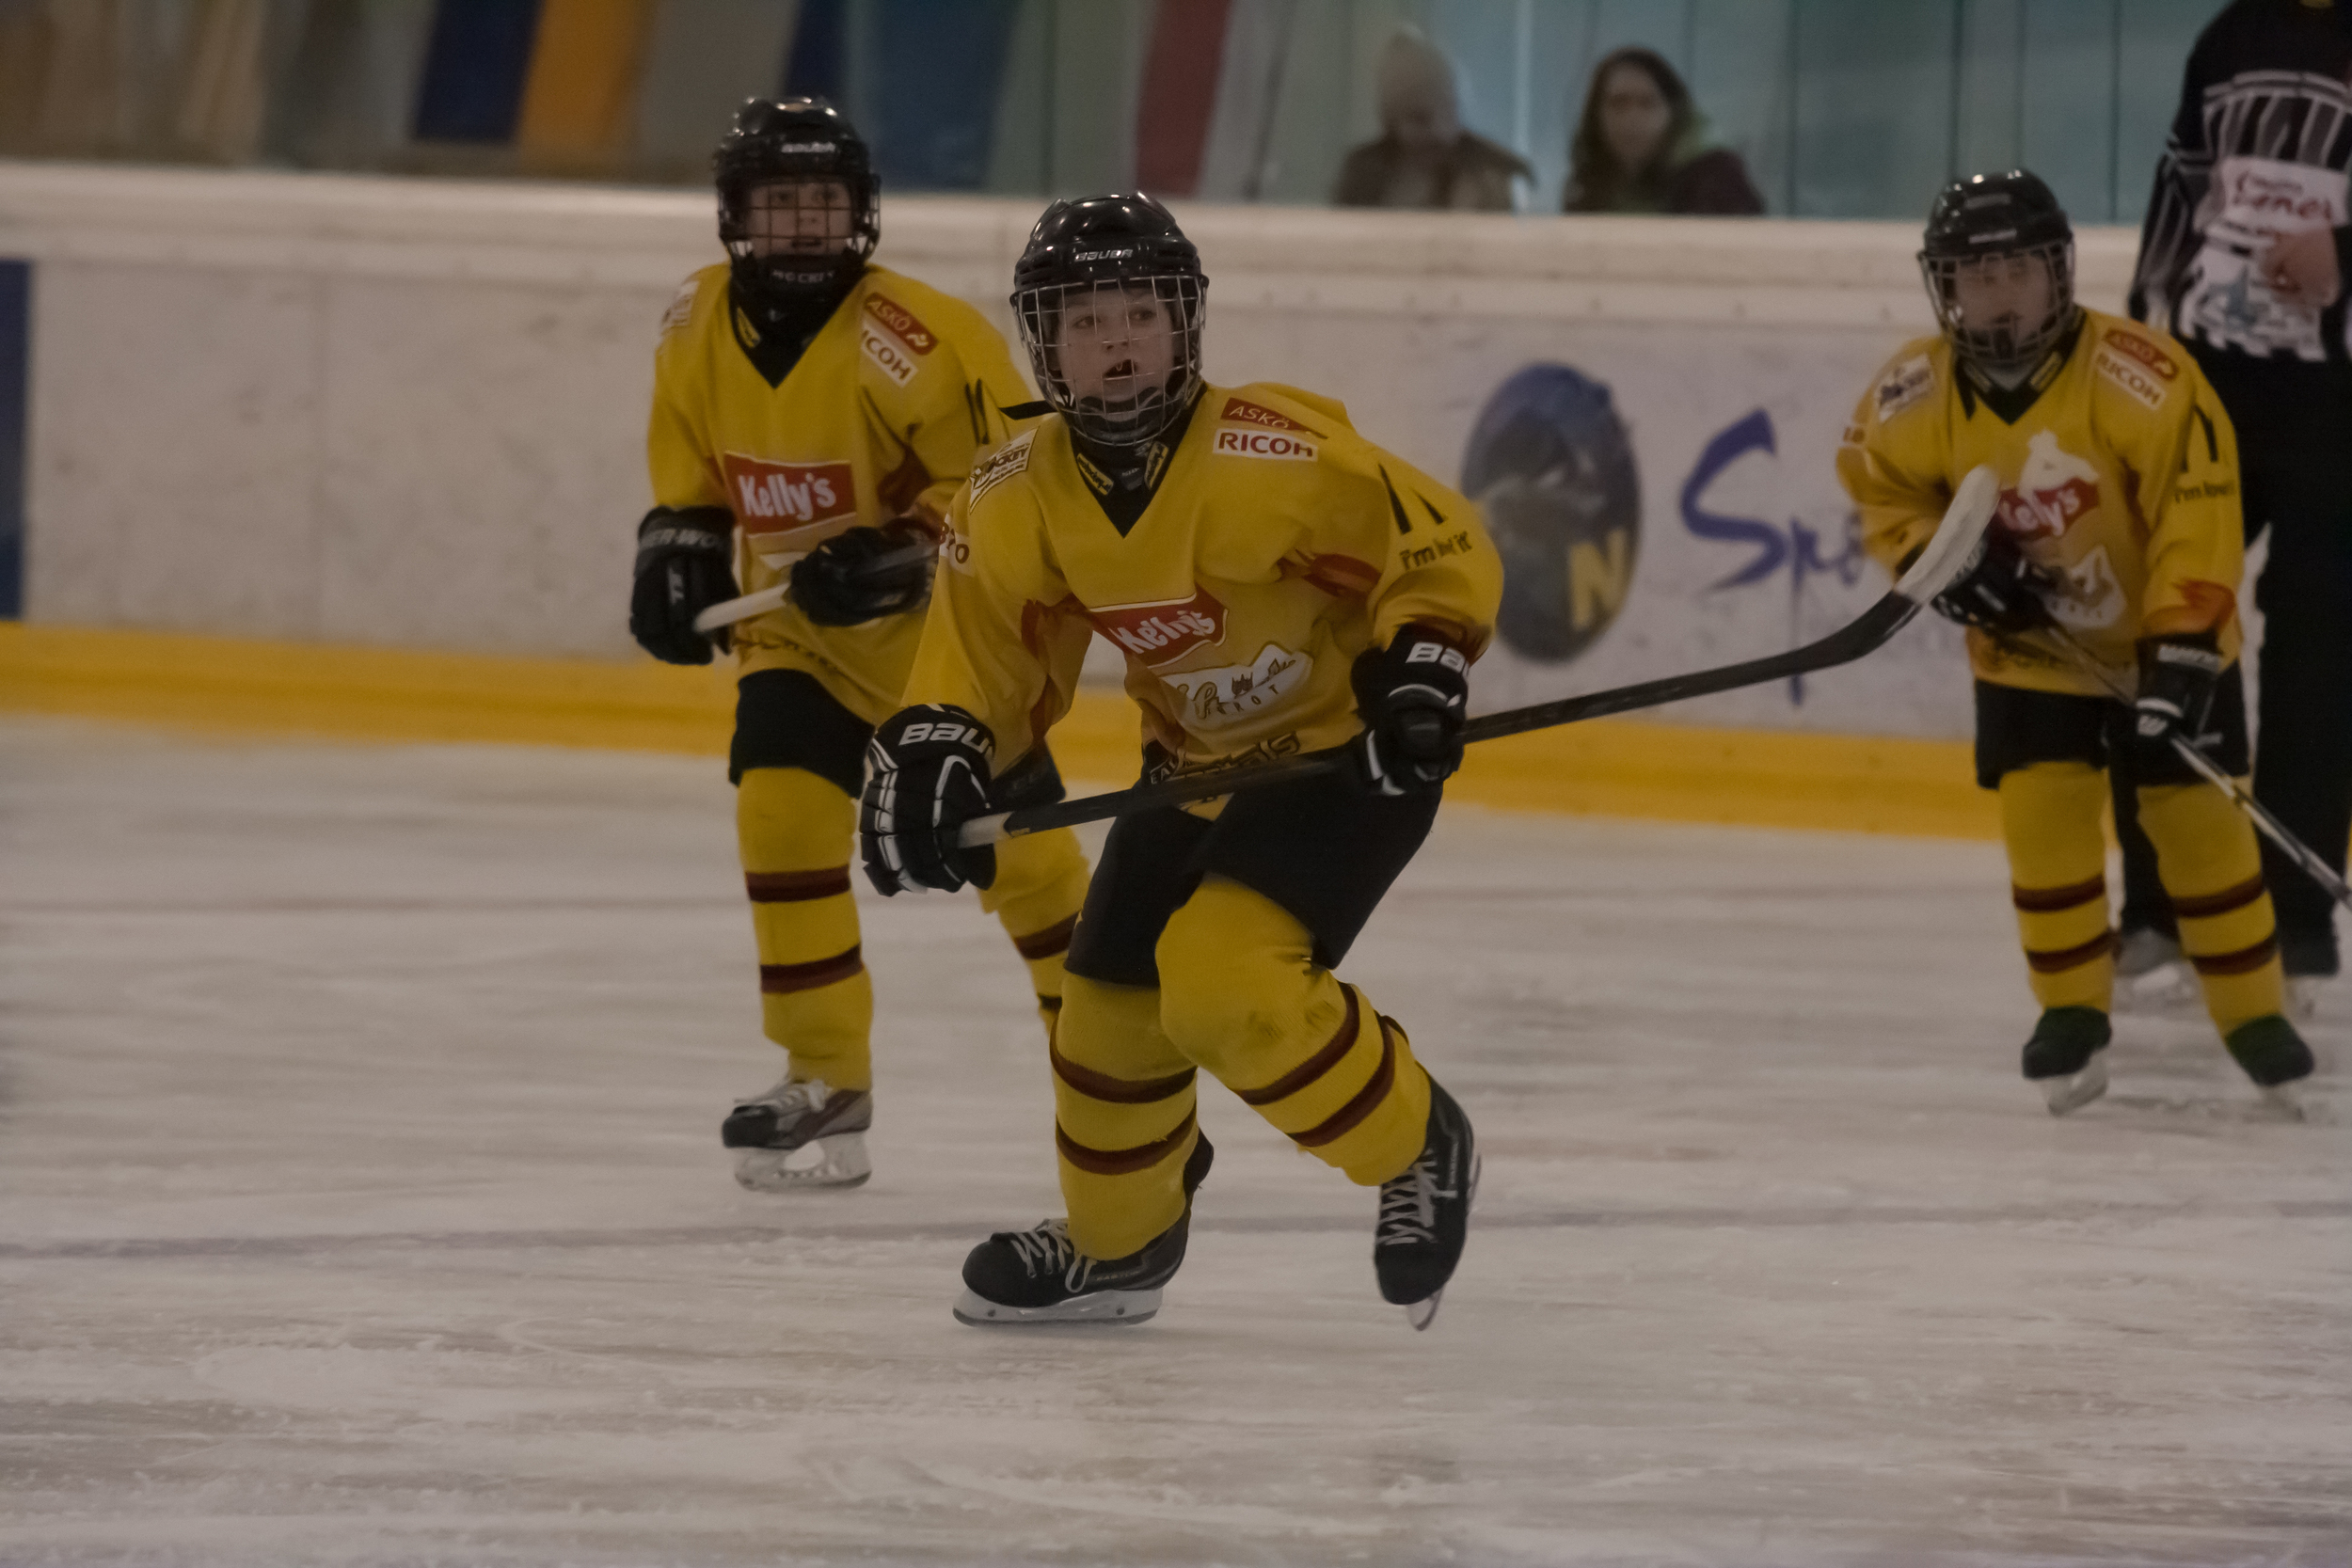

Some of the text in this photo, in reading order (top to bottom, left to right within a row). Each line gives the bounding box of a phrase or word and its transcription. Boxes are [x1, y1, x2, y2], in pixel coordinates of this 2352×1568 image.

[1074, 248, 1134, 262] BAUER
[1229, 405, 1290, 429] ASKÖ
[1218, 432, 1313, 457] RICOH
[738, 472, 837, 521] Kelly's
[1108, 610, 1216, 655] Kelly's
